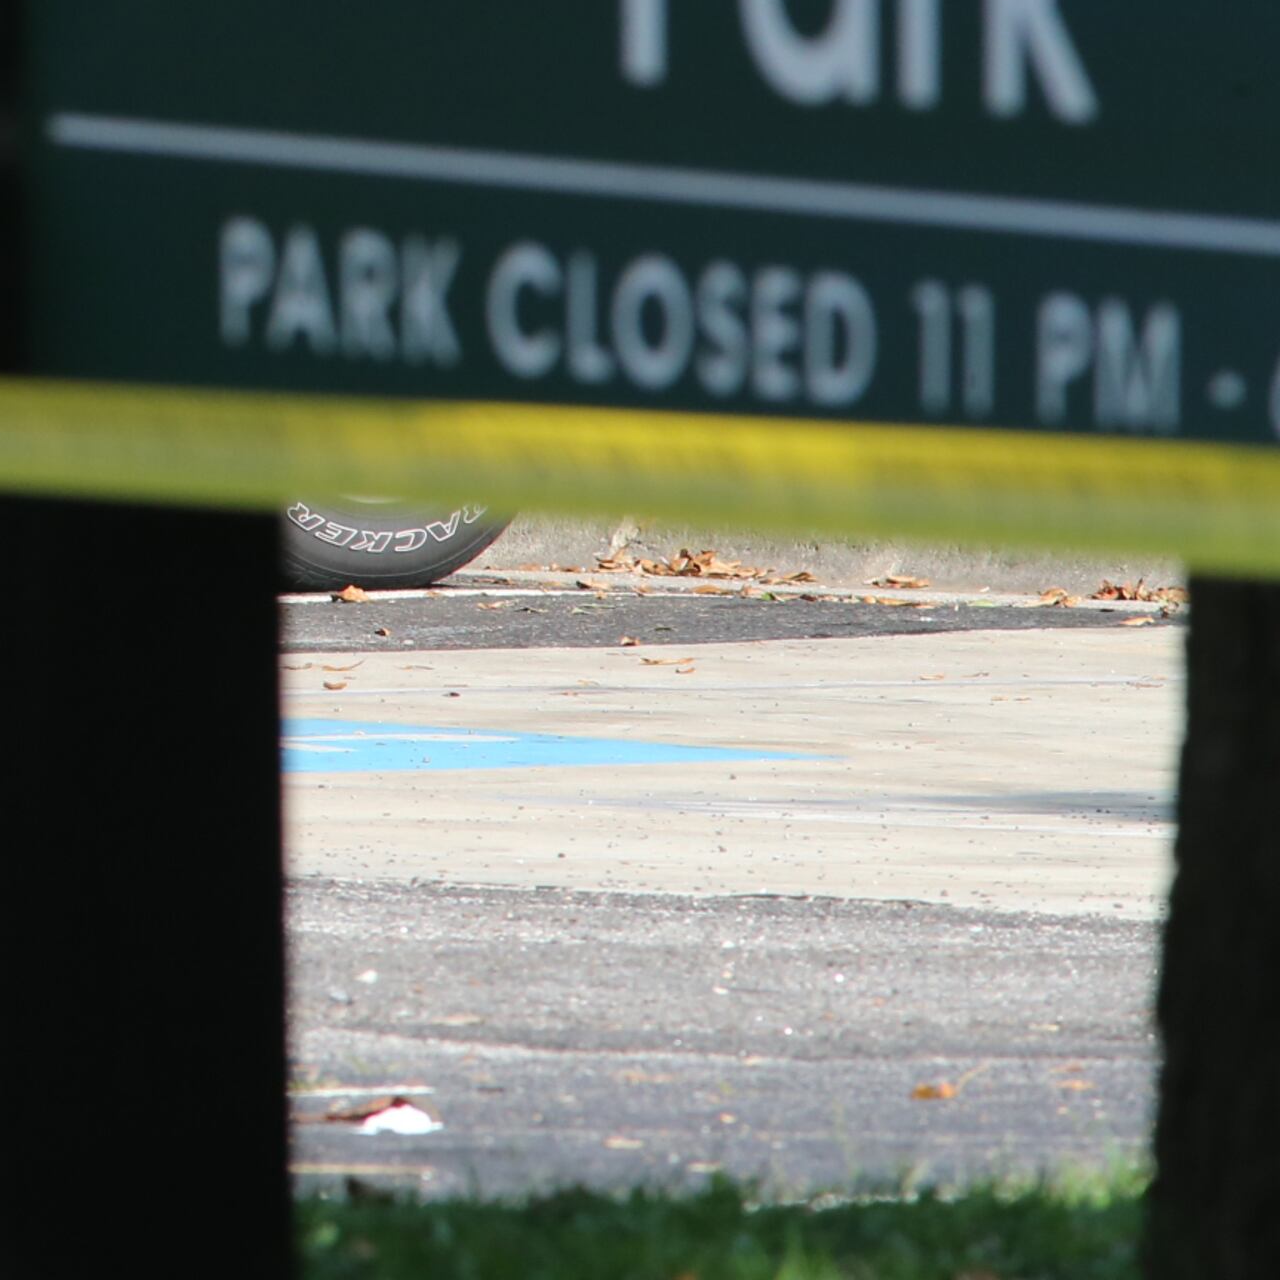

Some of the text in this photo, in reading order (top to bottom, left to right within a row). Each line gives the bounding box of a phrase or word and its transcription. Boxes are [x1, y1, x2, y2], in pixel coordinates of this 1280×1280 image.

[219, 216, 463, 368] PARK
[486, 240, 878, 408] CLOSED
[912, 277, 996, 418] 11
[1035, 289, 1183, 436] PM
